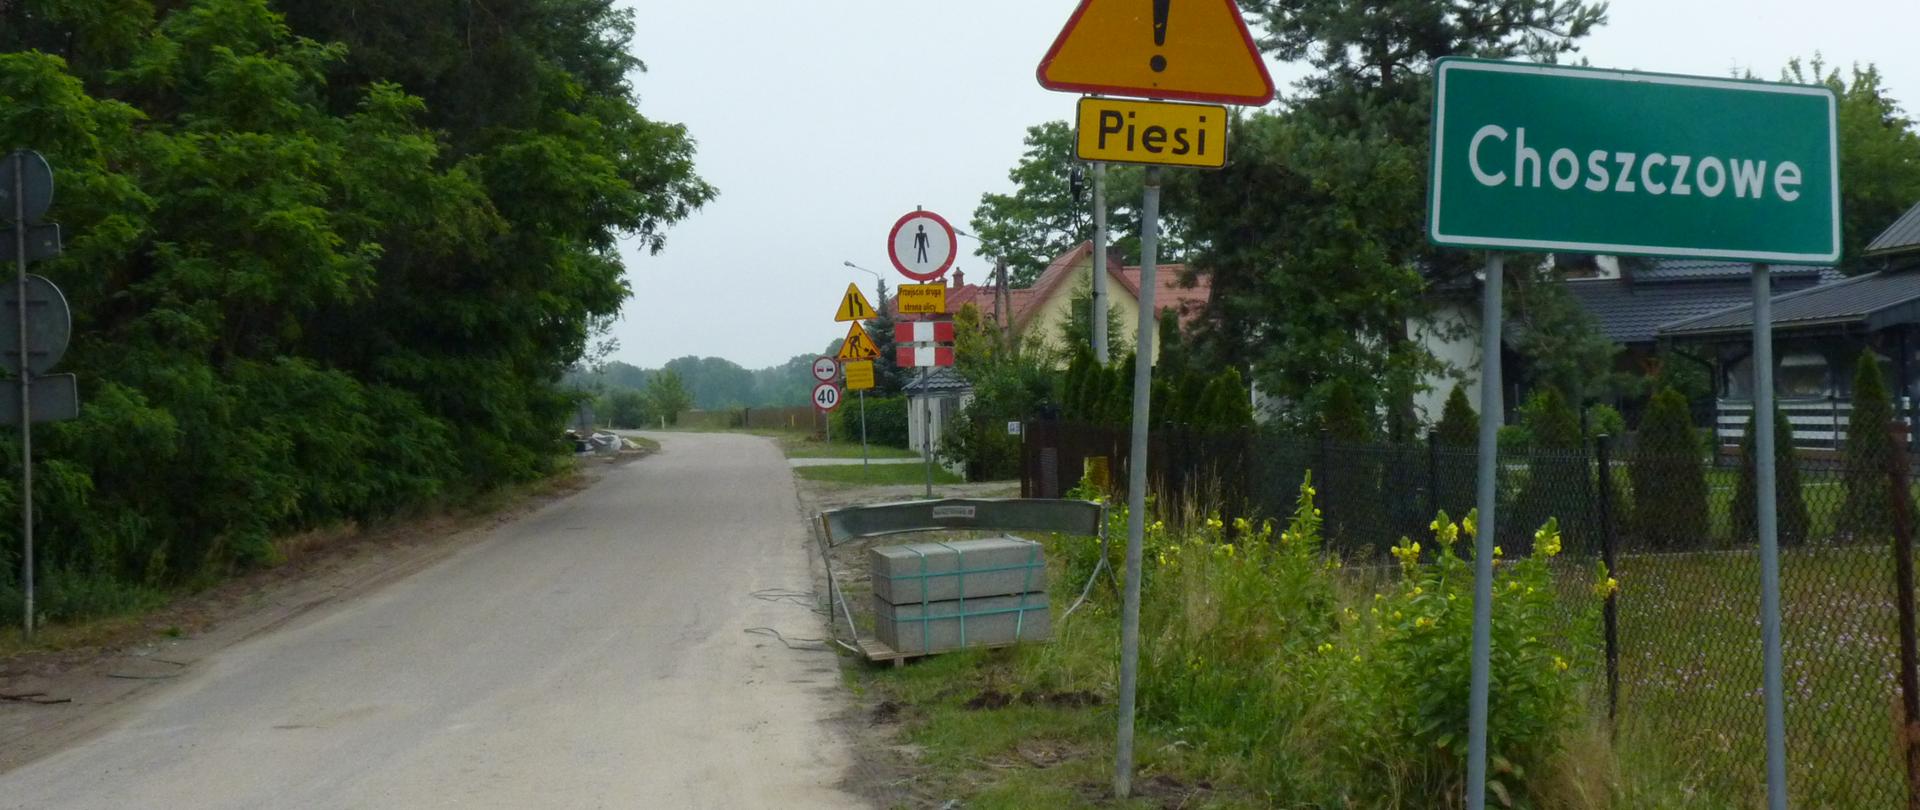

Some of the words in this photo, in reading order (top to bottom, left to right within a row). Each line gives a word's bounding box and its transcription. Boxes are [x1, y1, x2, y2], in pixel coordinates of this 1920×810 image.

[1098, 109, 1207, 156] Piesi
[1468, 123, 1802, 202] Choszczowe
[817, 389, 835, 404] 40
